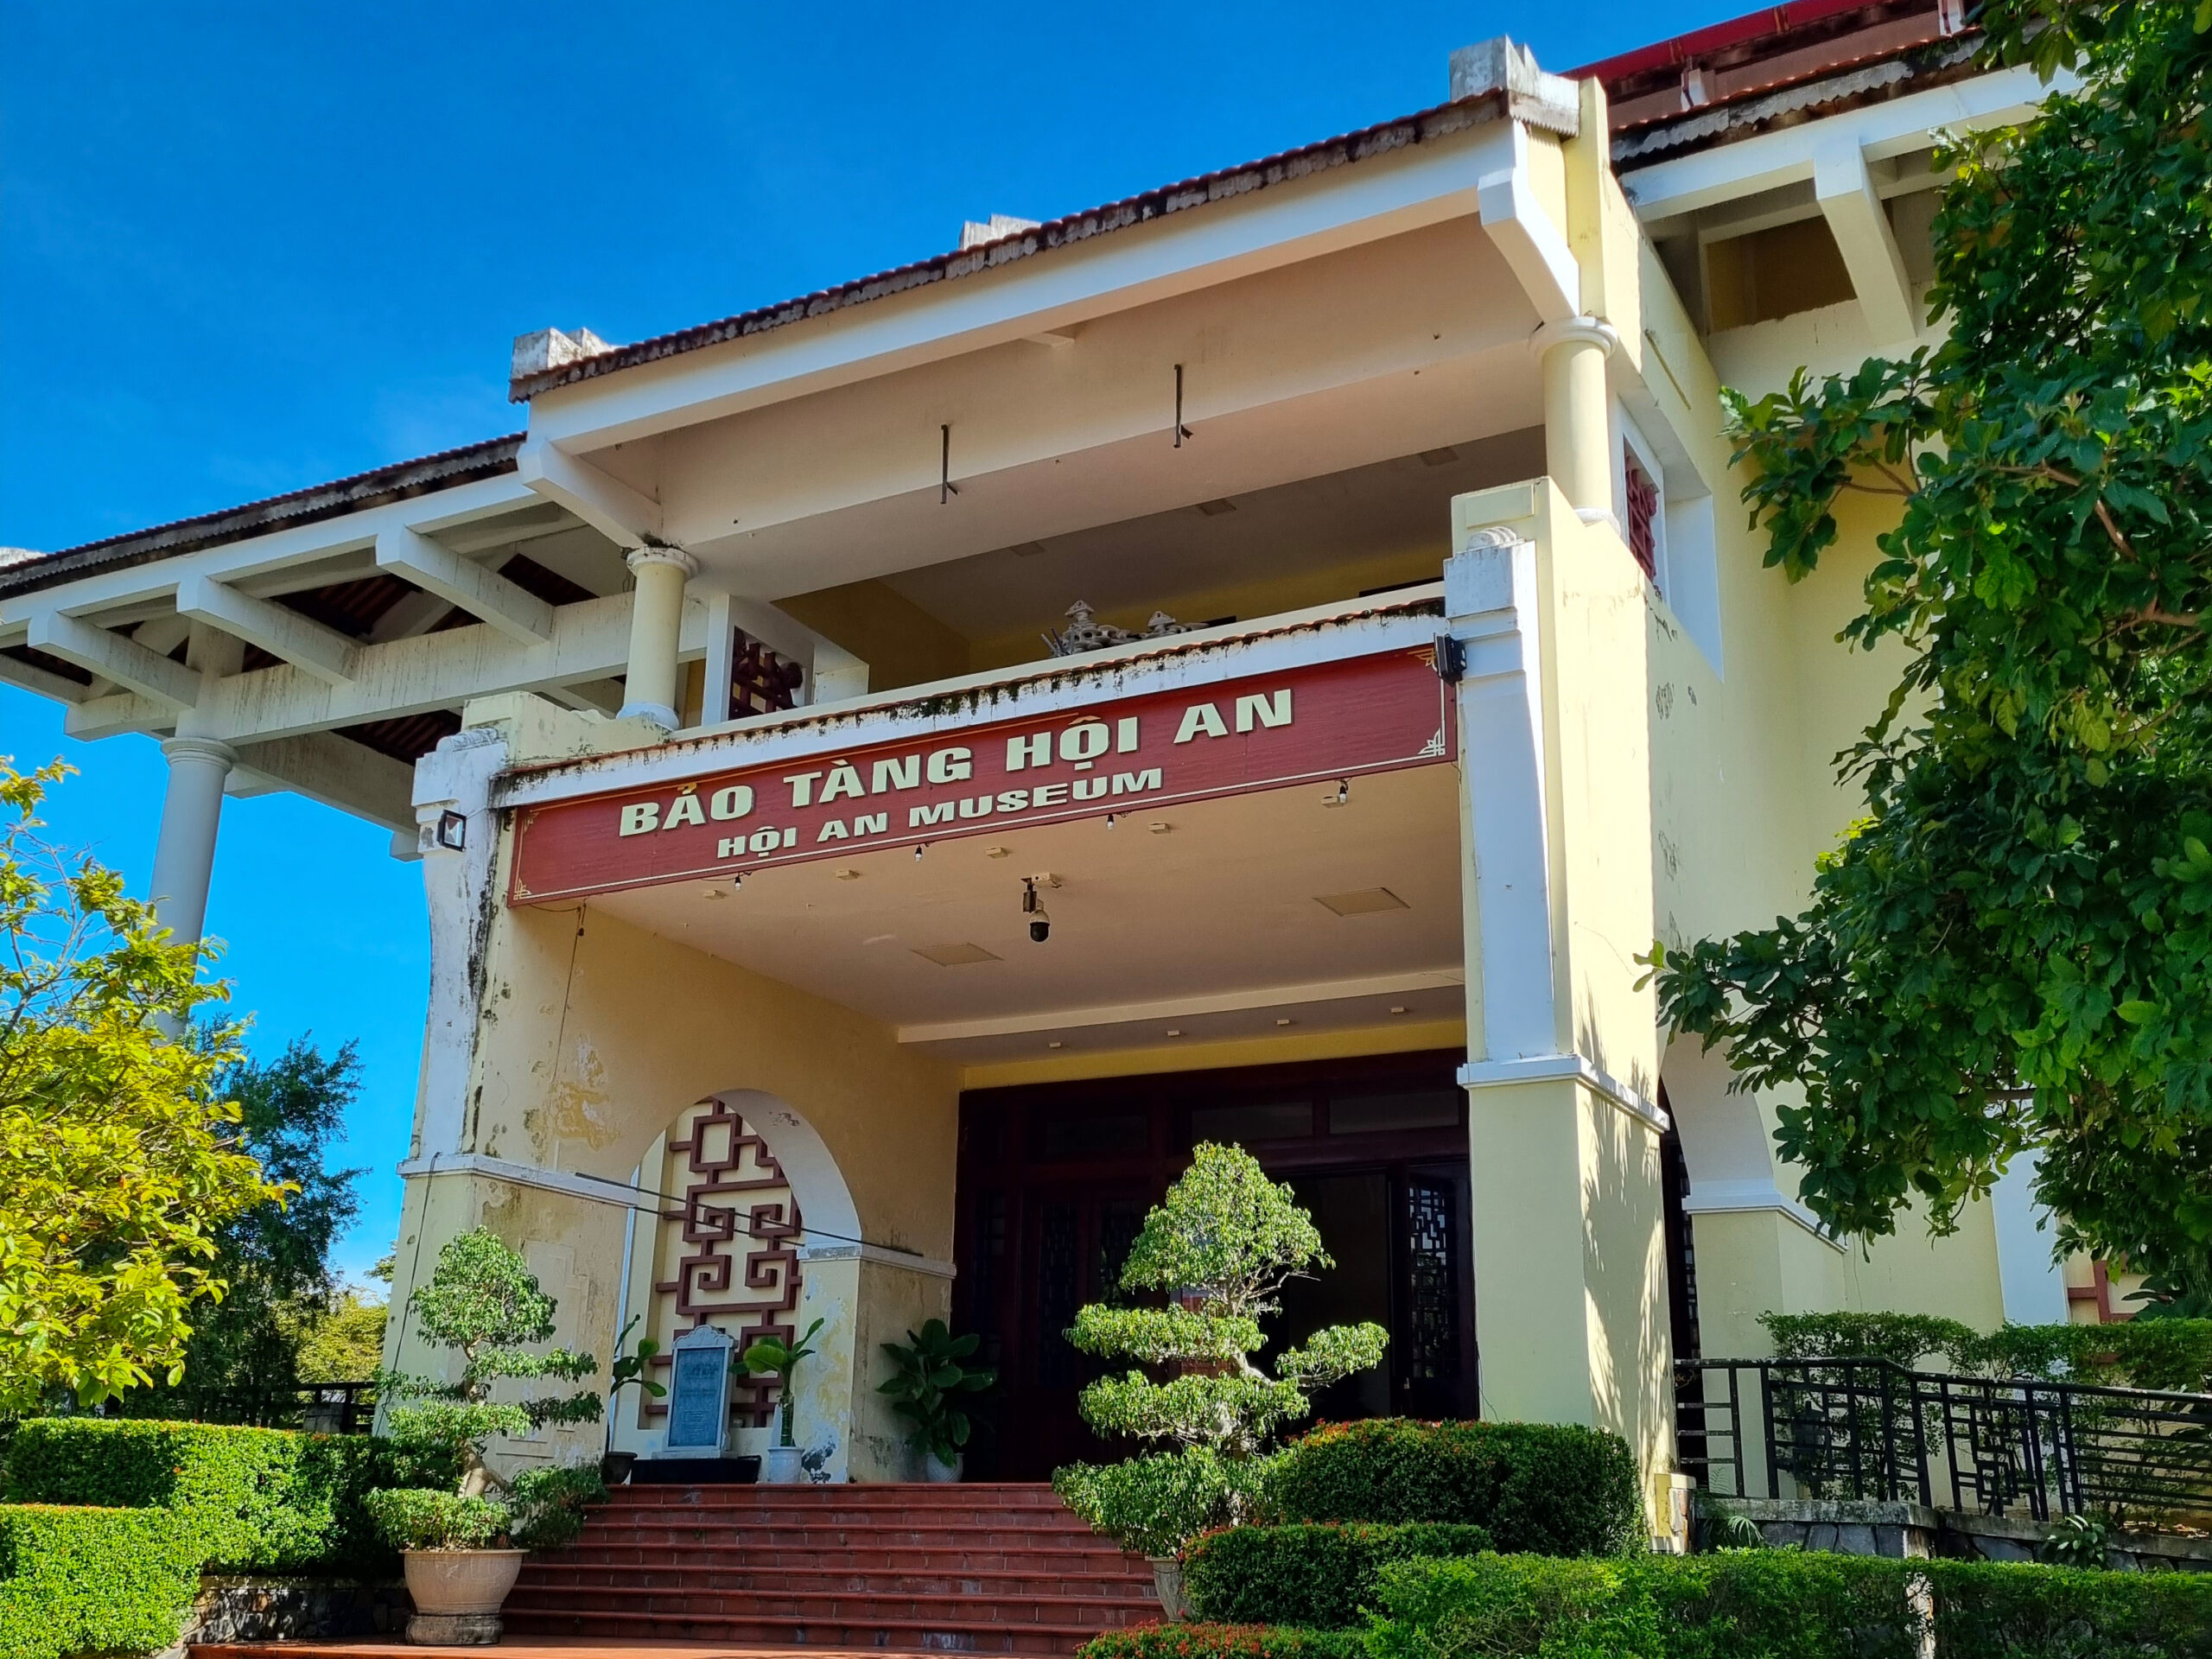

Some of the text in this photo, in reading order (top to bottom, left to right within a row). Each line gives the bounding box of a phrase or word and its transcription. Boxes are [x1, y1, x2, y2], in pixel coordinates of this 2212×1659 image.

[619, 689, 1293, 837] BẢO TÀNG HỘI AN
[716, 767, 1163, 858] HỘI AN MUSEUM
